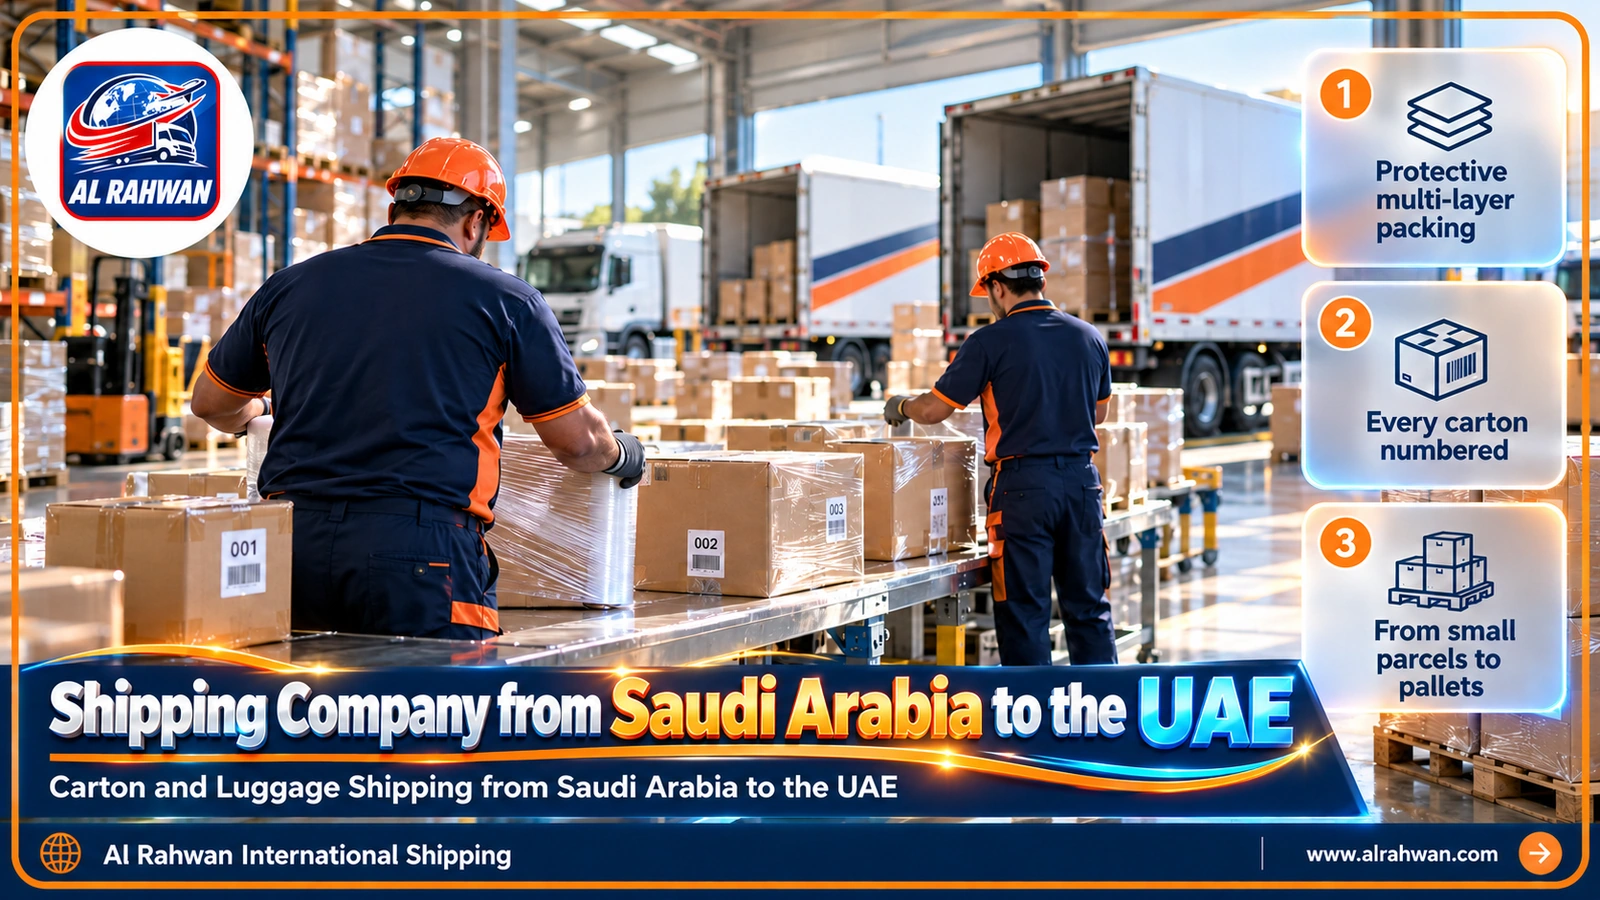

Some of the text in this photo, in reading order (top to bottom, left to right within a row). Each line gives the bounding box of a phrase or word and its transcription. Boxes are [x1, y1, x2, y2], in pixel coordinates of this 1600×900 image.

[829, 502, 844, 516] 003
[230, 539, 257, 558] 001
[694, 536, 718, 550] 002
